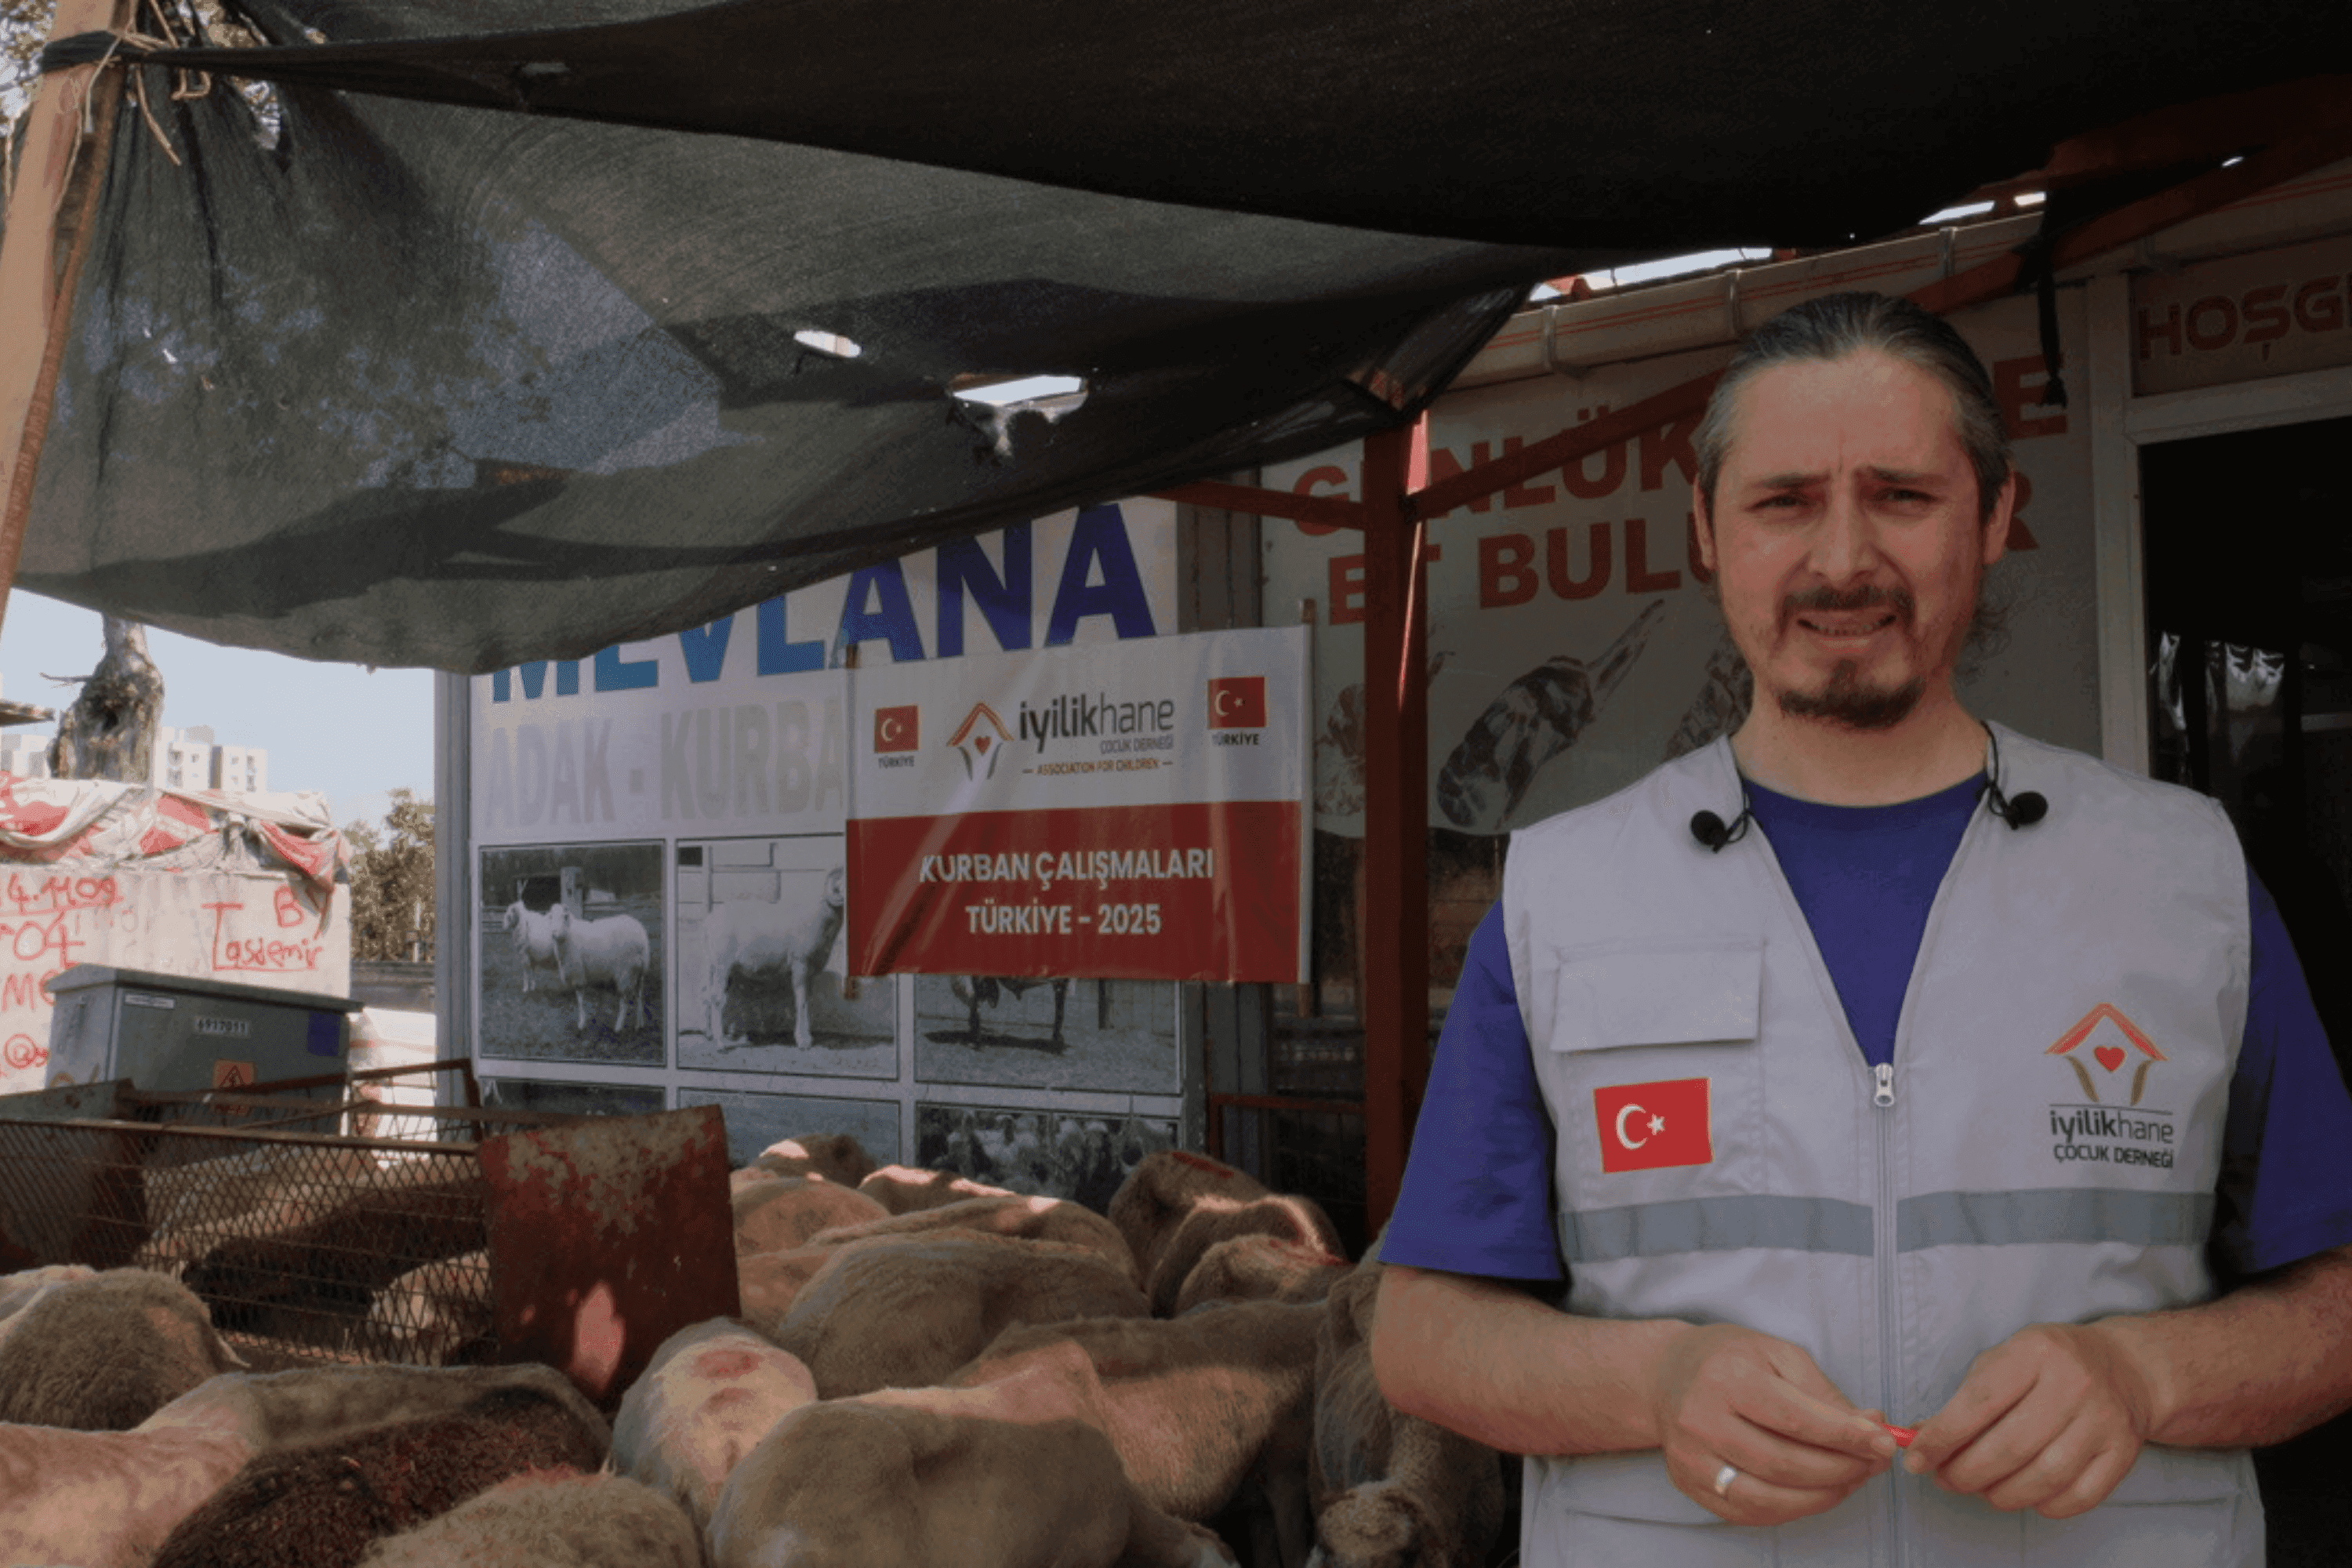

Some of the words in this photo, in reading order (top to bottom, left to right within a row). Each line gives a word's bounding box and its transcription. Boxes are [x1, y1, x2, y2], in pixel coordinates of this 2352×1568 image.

[2136, 273, 2352, 361] HOŞG
[1293, 405, 1700, 536] GNLÜK
[1020, 691, 1174, 753] iyilikhane
[485, 717, 615, 828] ADAK
[661, 694, 844, 822] KURBA
[920, 853, 1030, 883] KURBAN
[1035, 848, 1214, 891] ÇALIŞMALARI
[965, 897, 1073, 935] TÜRKİYE
[1098, 903, 1162, 935] 2025
[2049, 1109, 2173, 1144] iyilikhane
[2054, 1144, 2110, 1163] ÇOCUK
